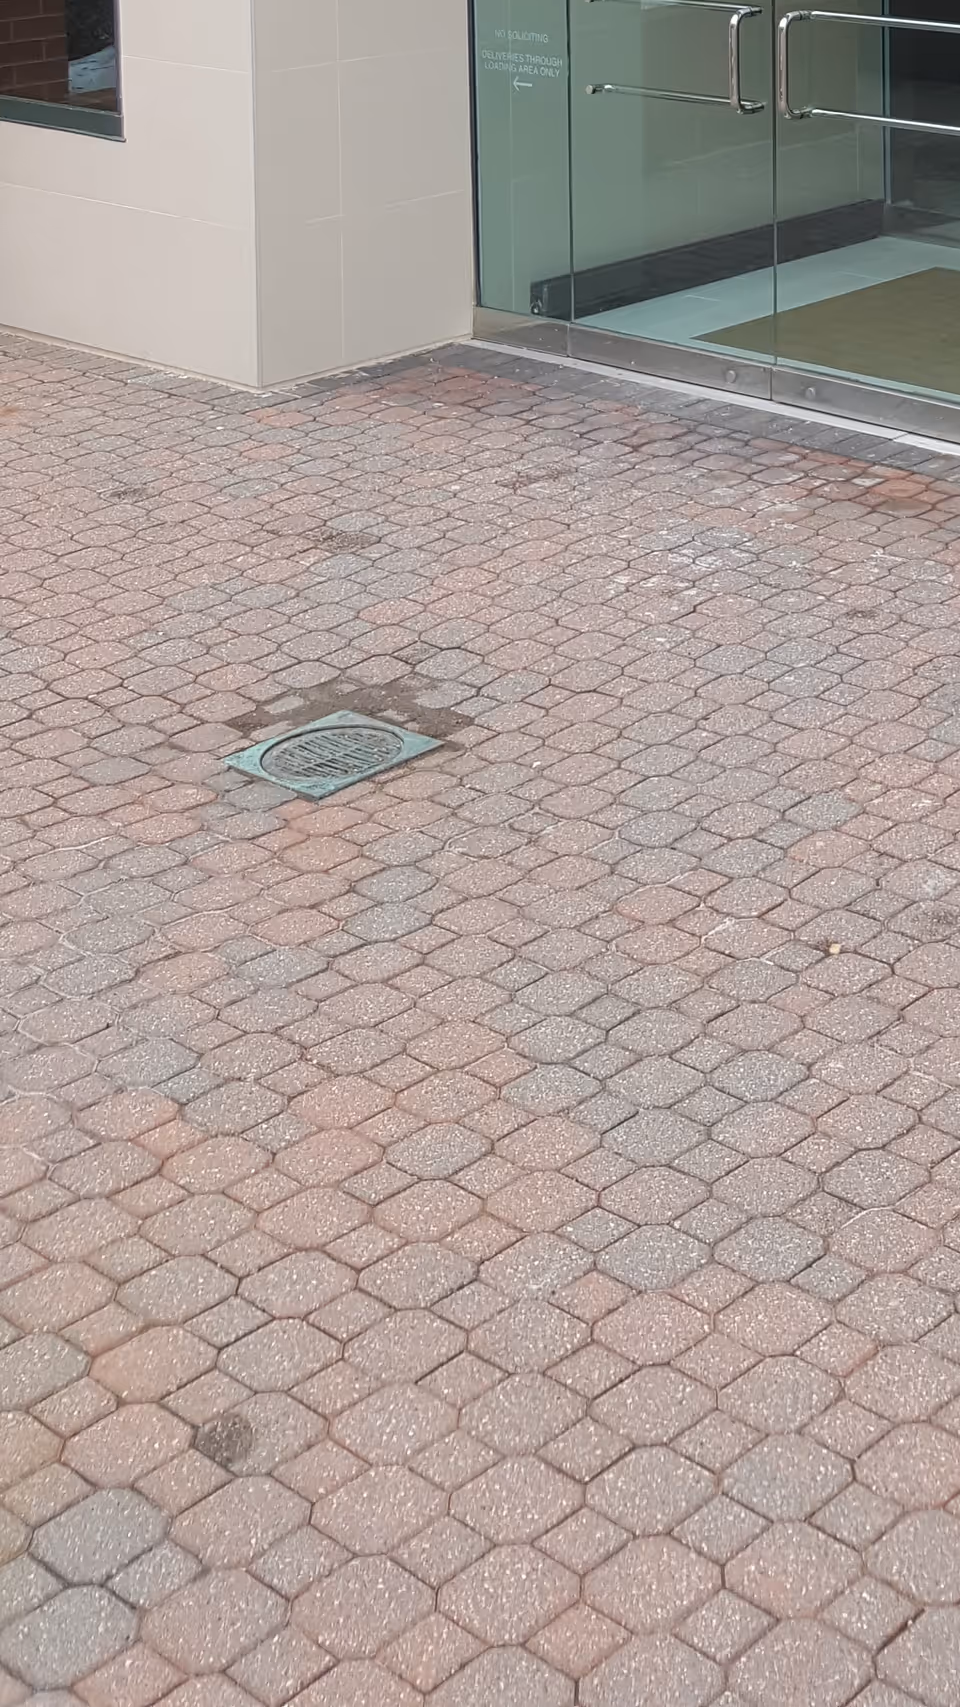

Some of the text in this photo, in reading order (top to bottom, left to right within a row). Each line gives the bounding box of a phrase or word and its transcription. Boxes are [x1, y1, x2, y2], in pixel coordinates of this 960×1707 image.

[494, 29, 549, 43] NO SOLICITING
[481, 50, 563, 67] DELIVERIES THROUGH
[484, 62, 560, 78] LOADING AREA ONLY
